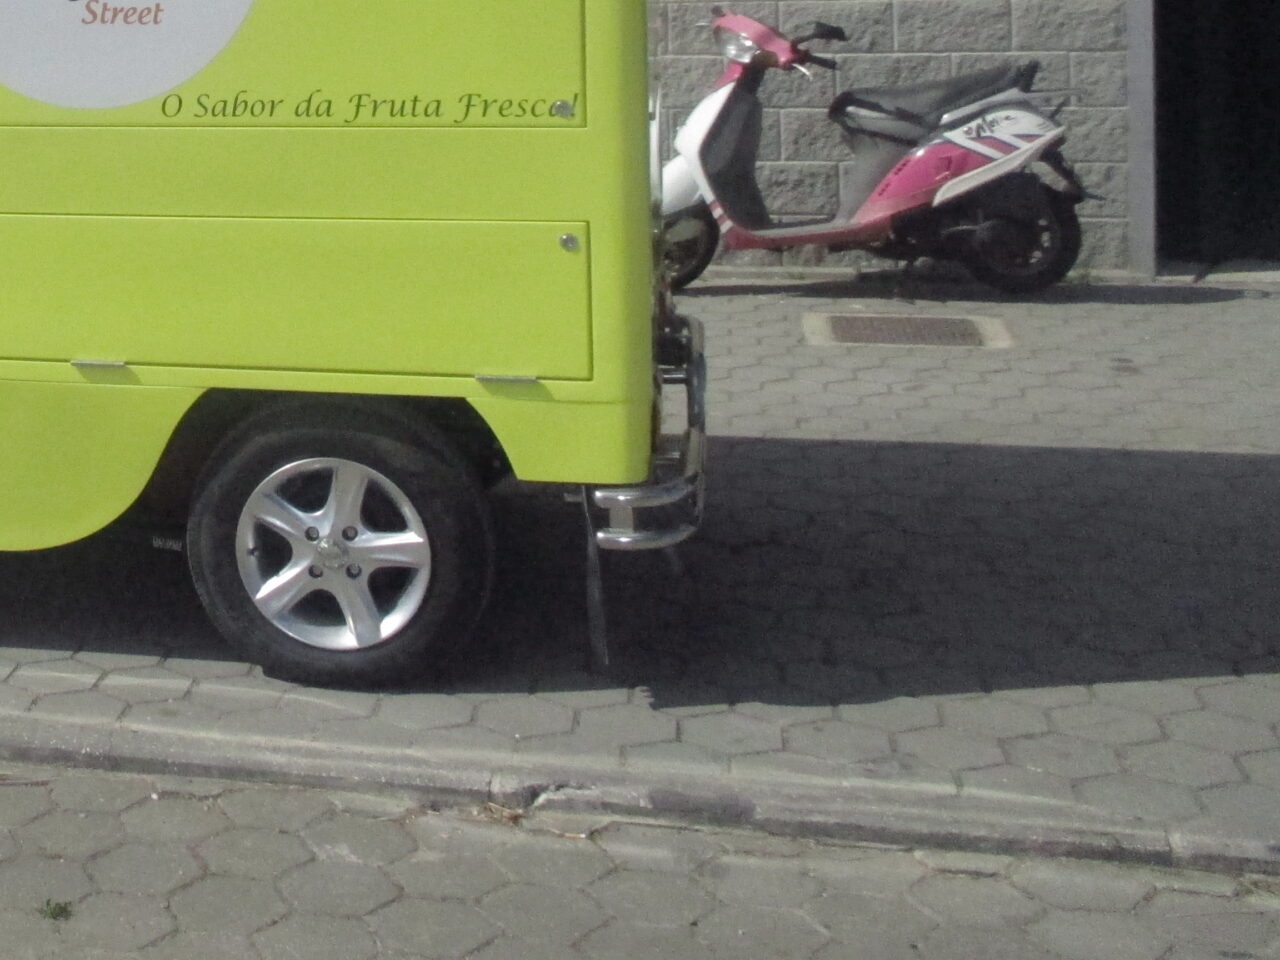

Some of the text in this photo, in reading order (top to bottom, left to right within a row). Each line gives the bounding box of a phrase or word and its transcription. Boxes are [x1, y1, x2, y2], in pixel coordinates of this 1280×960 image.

[161, 93, 183, 117] O
[193, 89, 284, 118] Sabor
[294, 88, 333, 118] da
[344, 92, 443, 123] Fruta
